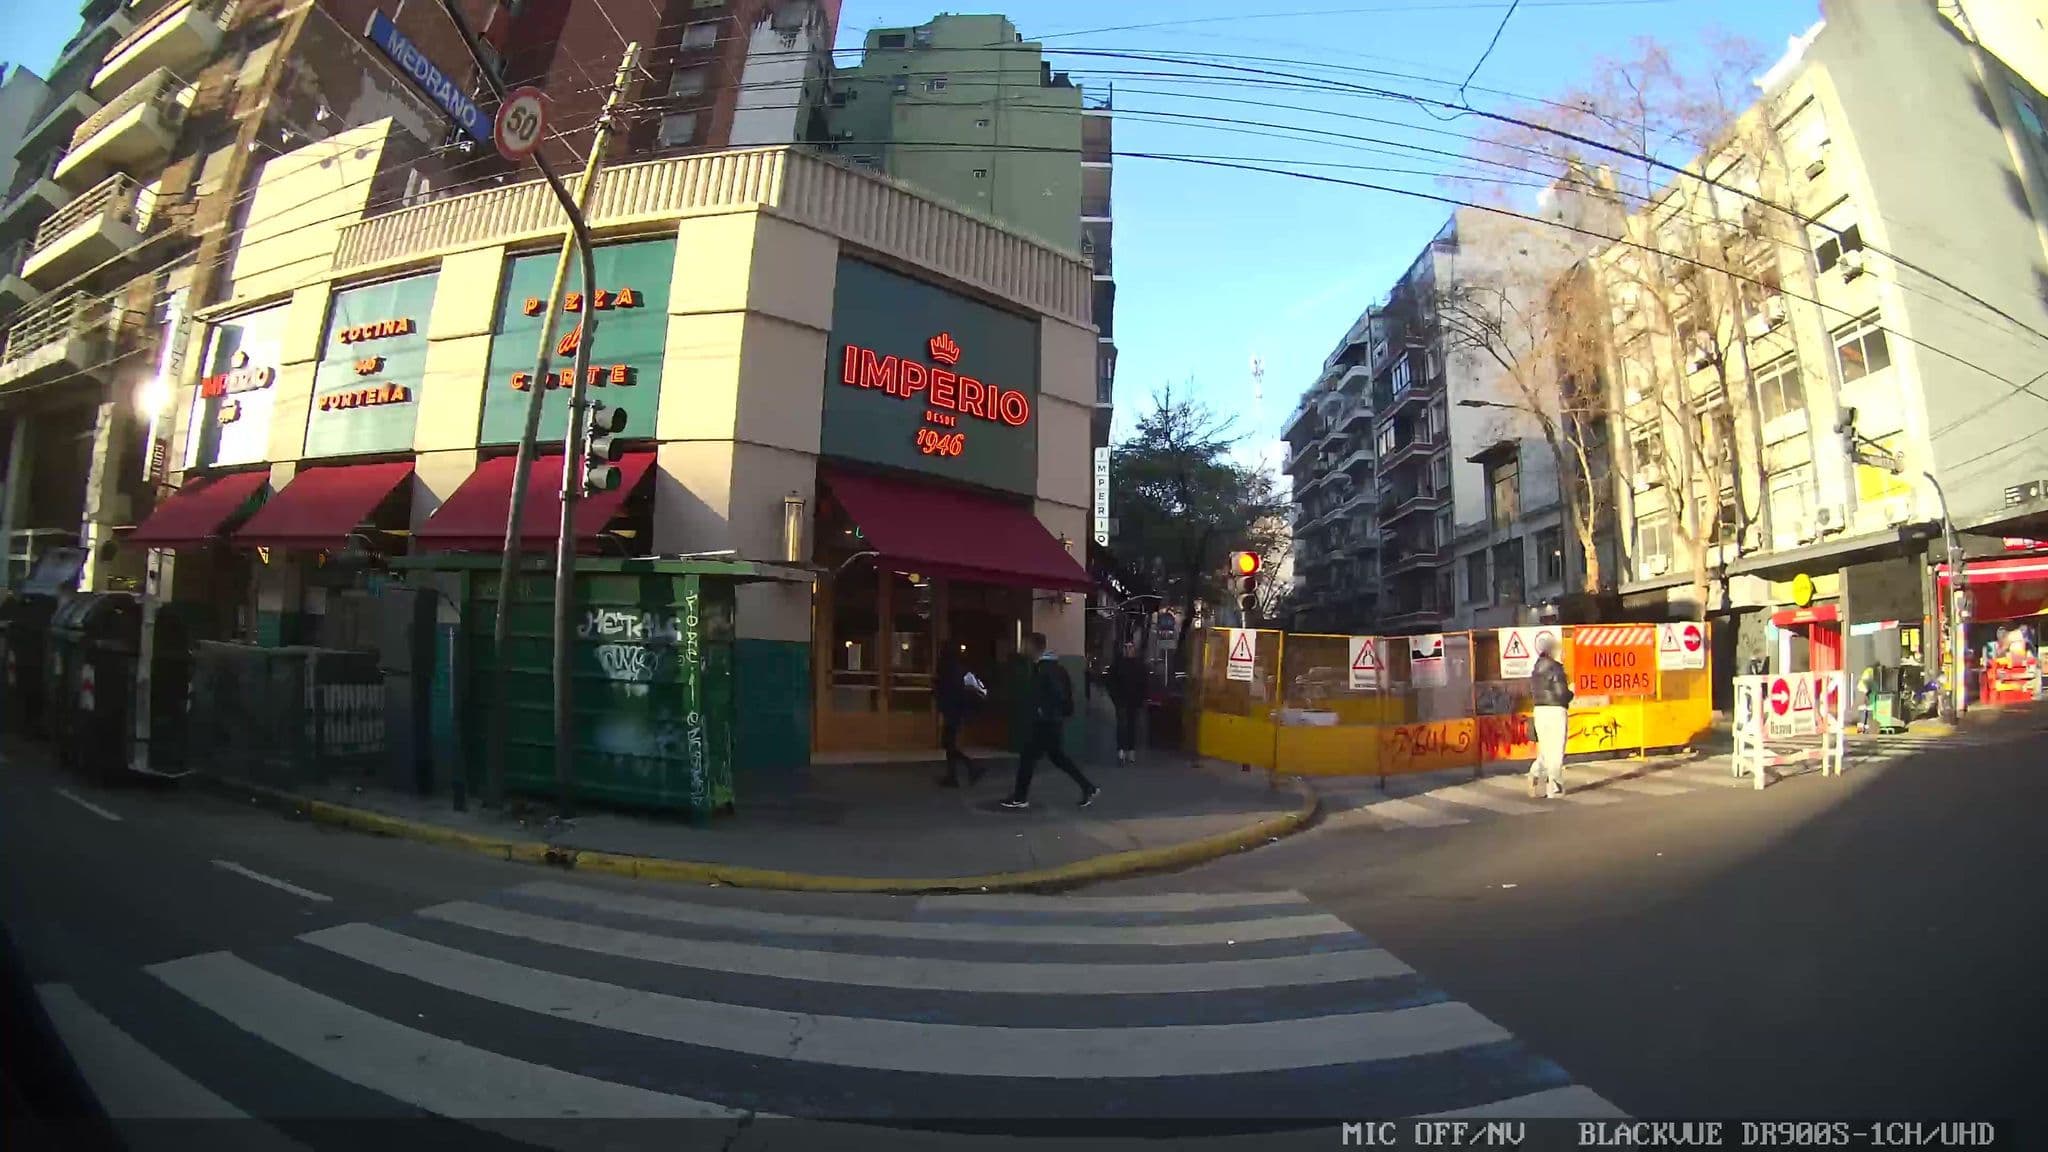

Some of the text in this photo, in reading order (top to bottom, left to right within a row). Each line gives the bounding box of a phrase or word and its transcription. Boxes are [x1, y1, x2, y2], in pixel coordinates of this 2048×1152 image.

[387, 29, 478, 128] MEDRANO
[506, 106, 538, 142] 50
[524, 287, 633, 316] PZZA
[337, 317, 412, 343] COCINA
[511, 364, 628, 391] CRTE
[842, 344, 1030, 427] IMPERIO
[926, 410, 956, 427] DESDE
[917, 428, 965, 456] 1946
[1096, 450, 1107, 544] IMPERIO
[1593, 651, 1636, 668] INICIO
[1580, 671, 1650, 690] DE OBRAS
